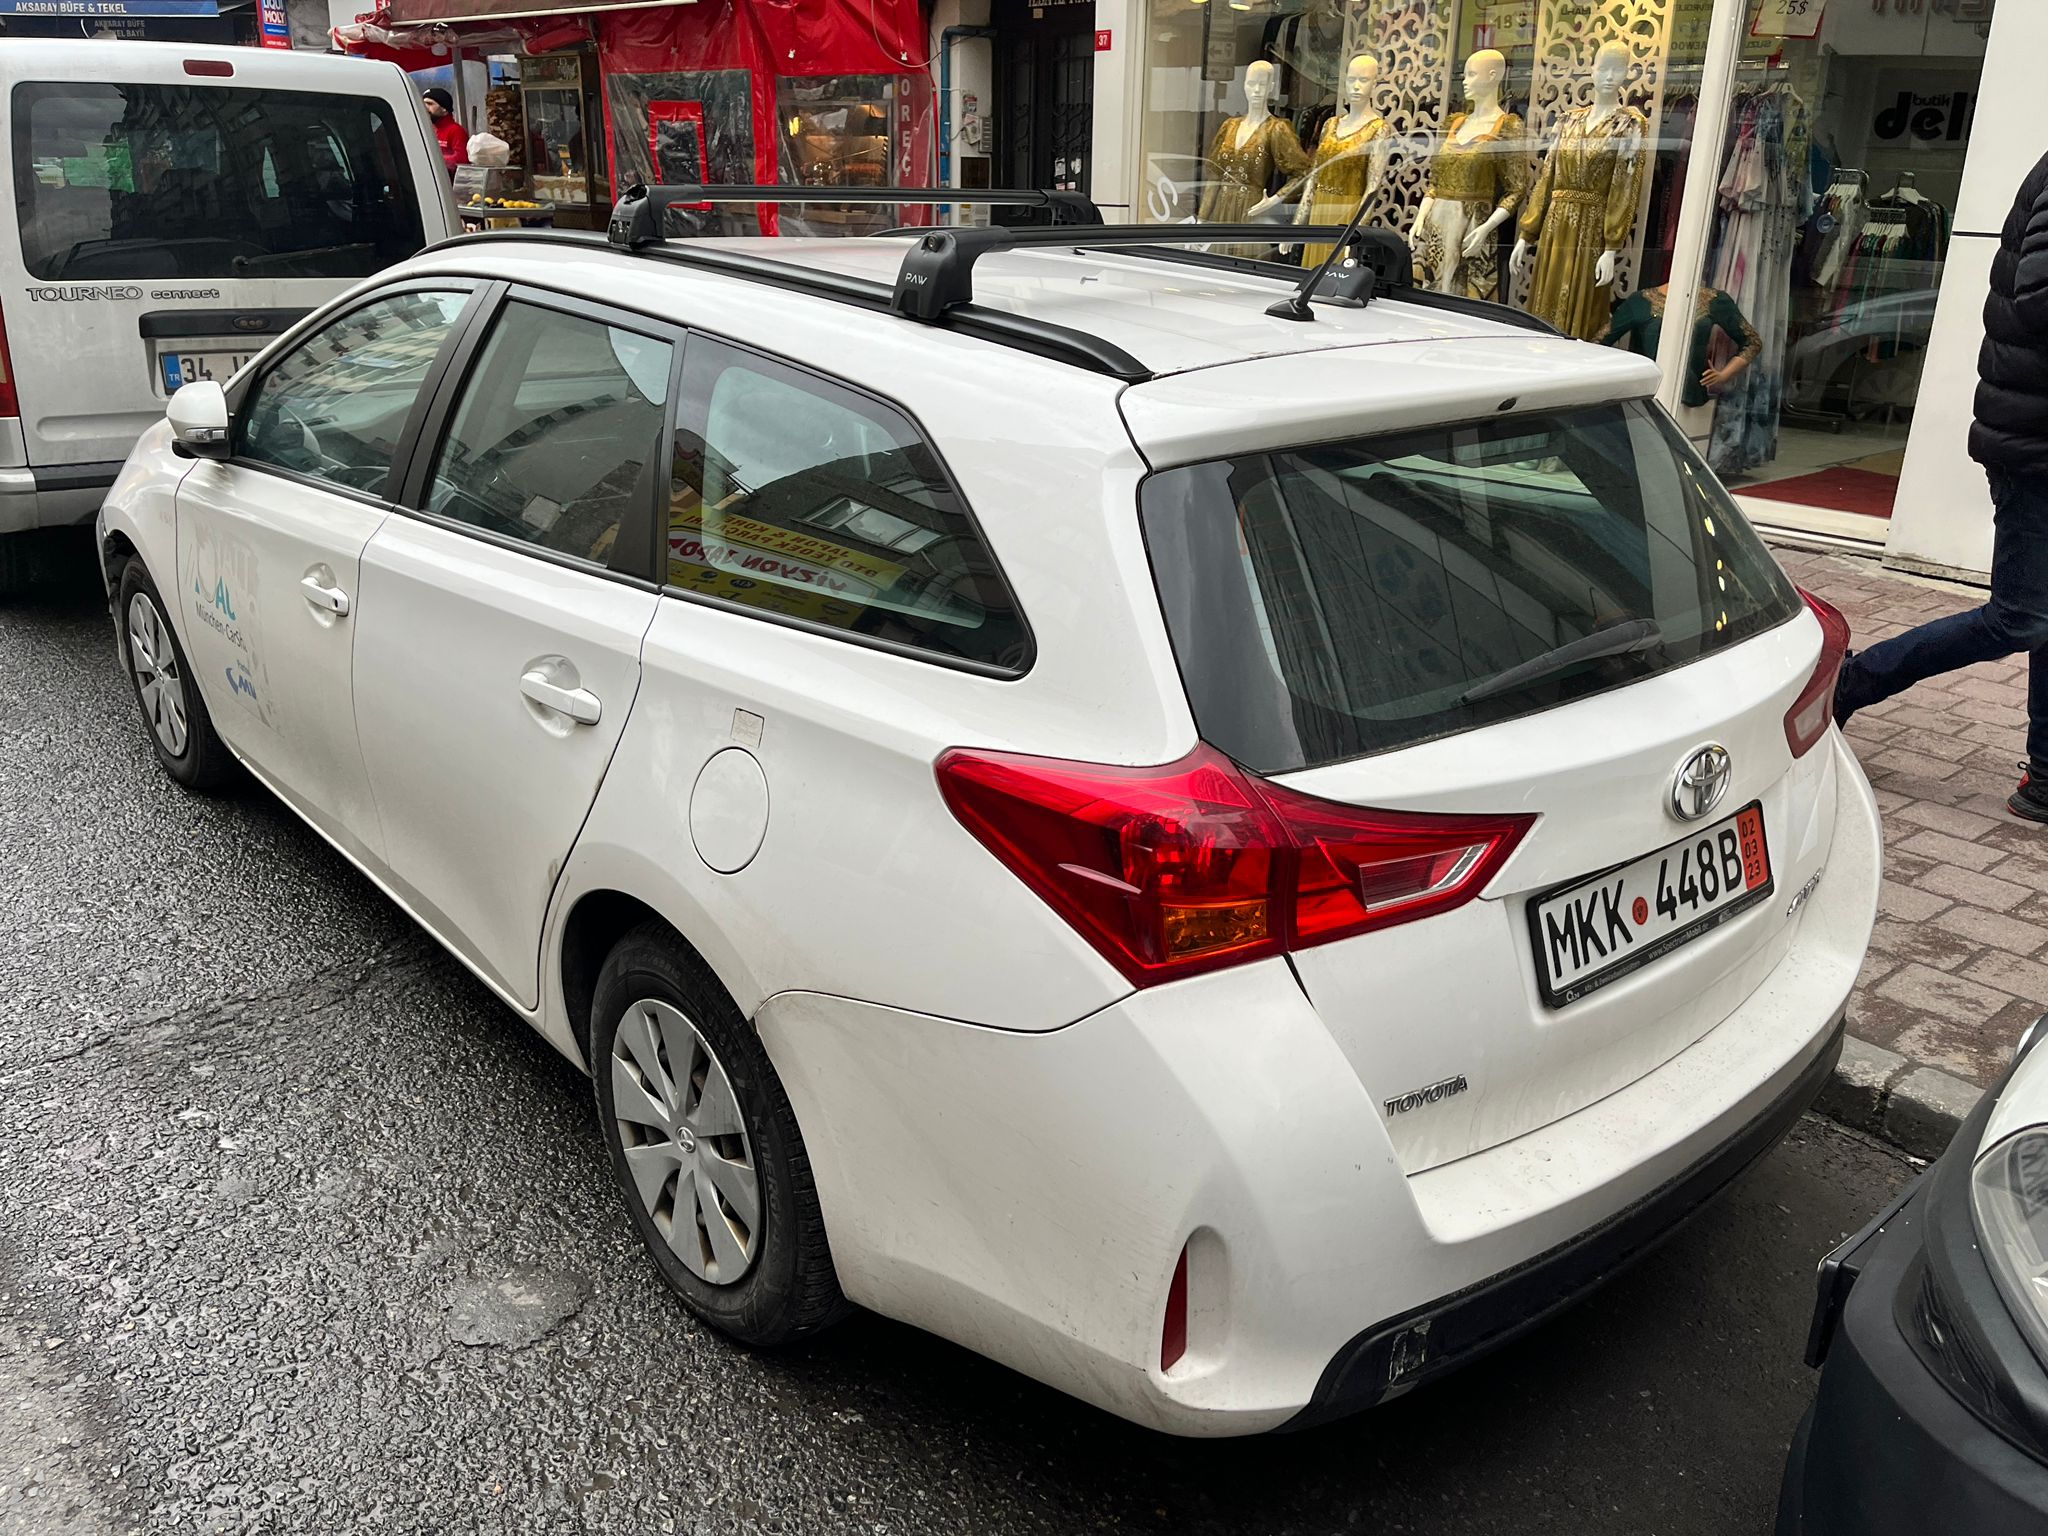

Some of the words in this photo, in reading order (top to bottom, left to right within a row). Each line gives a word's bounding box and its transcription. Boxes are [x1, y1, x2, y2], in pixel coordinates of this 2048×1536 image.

[15, 2, 58, 13] AKSARAY
[60, 1, 86, 13] BÜFE
[87, 3, 95, 13] &
[97, 4, 127, 13] TEKEL
[264, 11, 286, 25] MOLY
[1098, 34, 1108, 46] 37
[904, 272, 928, 286] PAW
[25, 286, 144, 302] TOURNEO
[151, 288, 220, 300] connect
[168, 372, 181, 382] TR
[180, 357, 213, 385] 34
[1742, 818, 1757, 837] 02
[1744, 838, 1759, 859] 03
[1747, 860, 1762, 881] 23
[1545, 879, 1634, 979] MKK
[1655, 828, 1744, 922] 448B
[1383, 1073, 1468, 1118] TOYOTA
